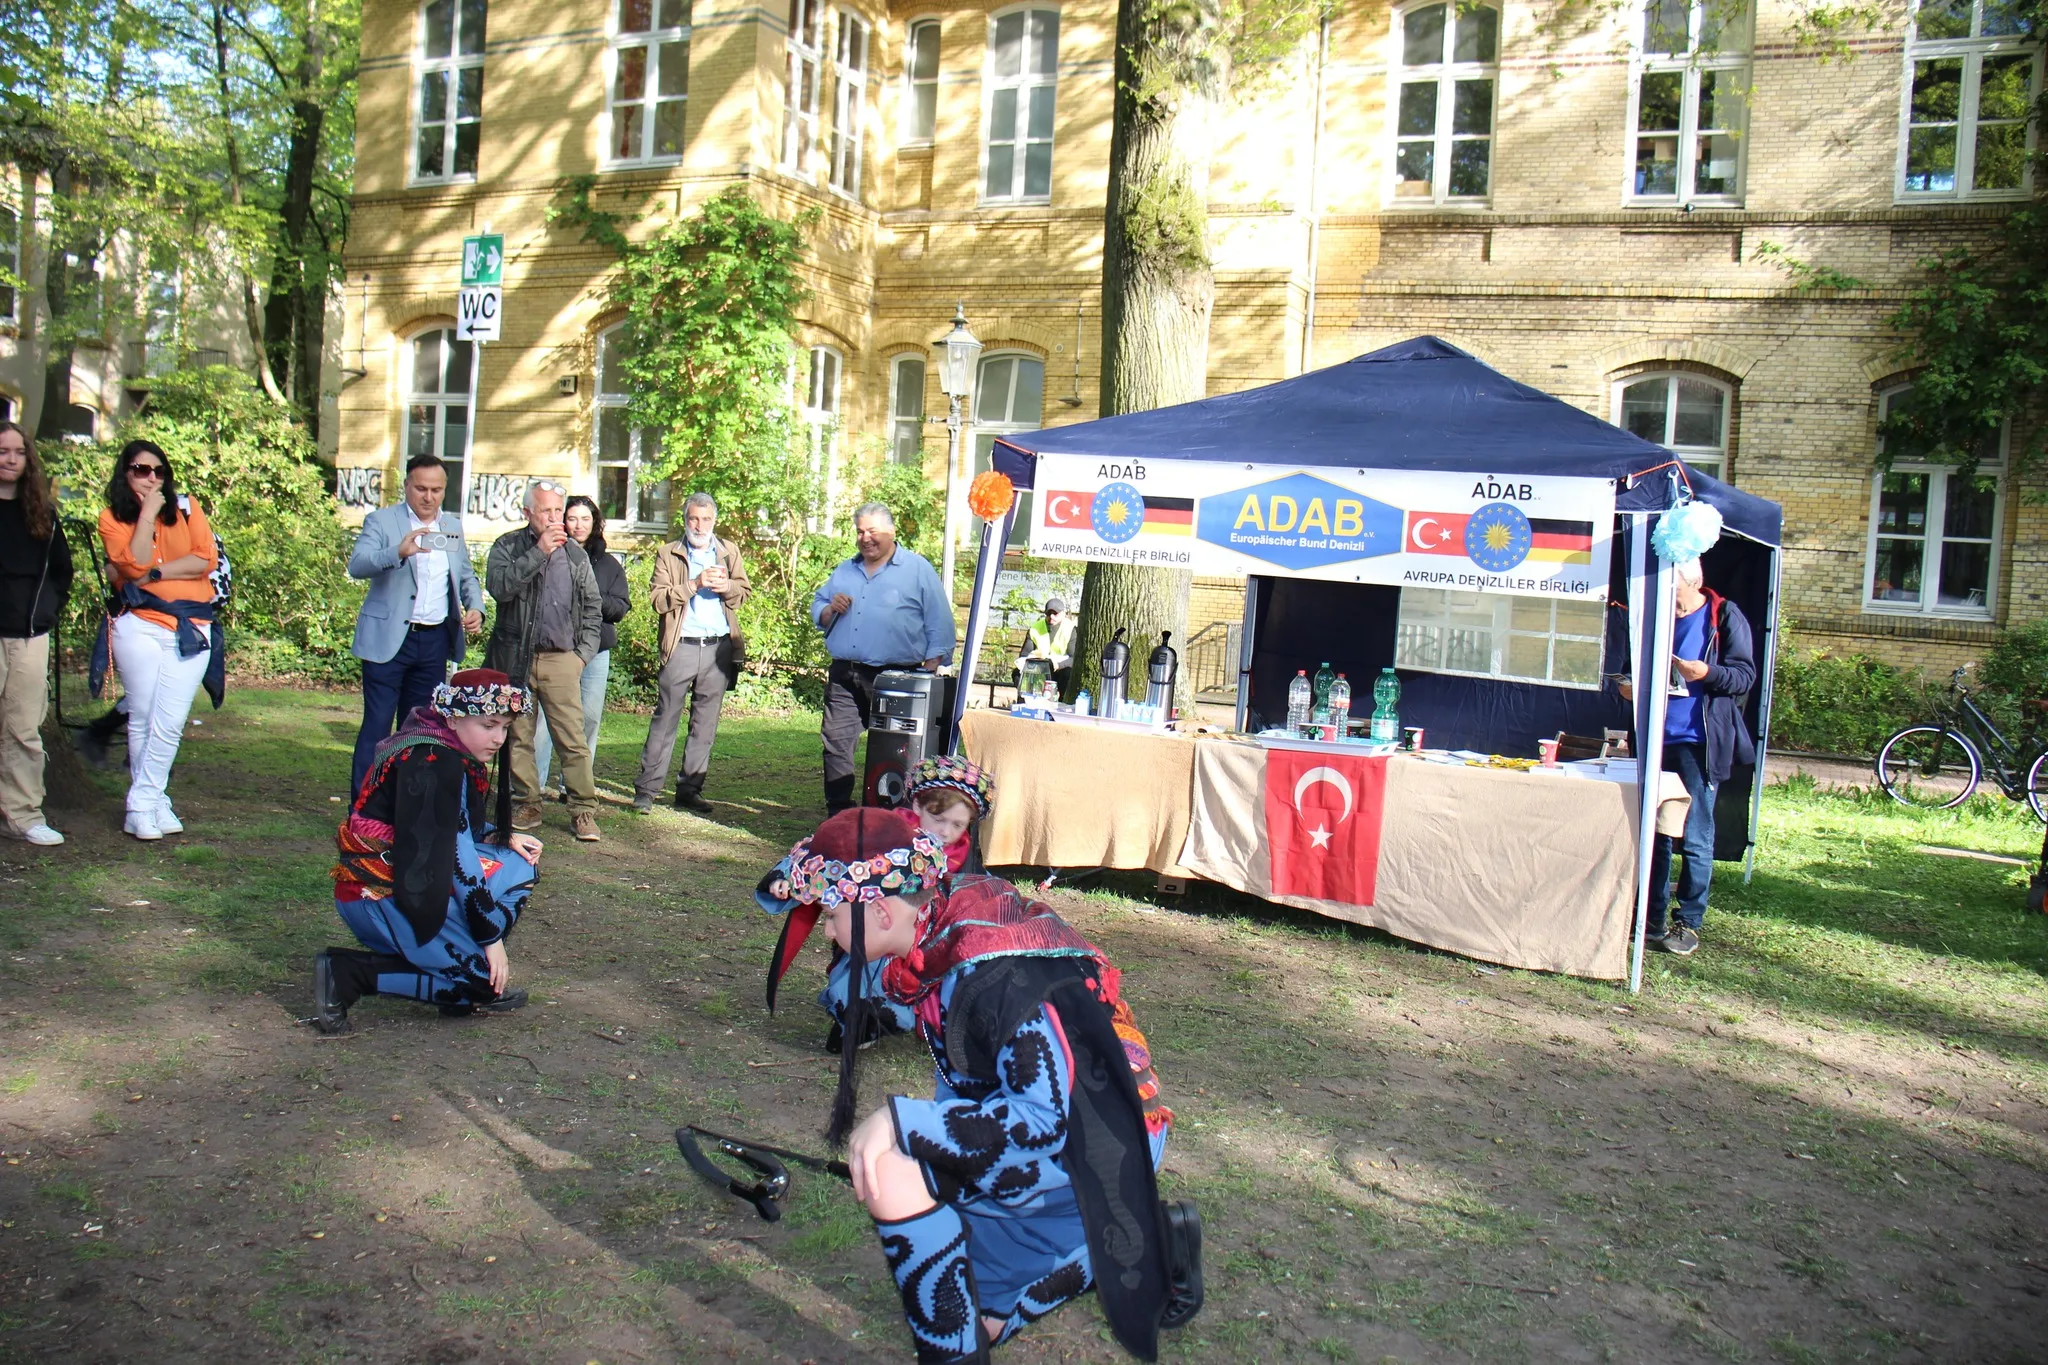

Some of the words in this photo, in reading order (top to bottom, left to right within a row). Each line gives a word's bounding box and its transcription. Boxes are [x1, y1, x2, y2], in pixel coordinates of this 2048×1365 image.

[462, 292, 497, 319] WC
[1097, 464, 1146, 480] ADAB
[1471, 482, 1533, 501] ADAB
[1233, 493, 1364, 537] ADAB
[1041, 543, 1083, 555] AVRUPA
[1230, 532, 1297, 547] Europäischer
[1299, 537, 1327, 549] Bund
[1329, 539, 1365, 551] Denizli
[1403, 570, 1455, 584] AVRUPA
